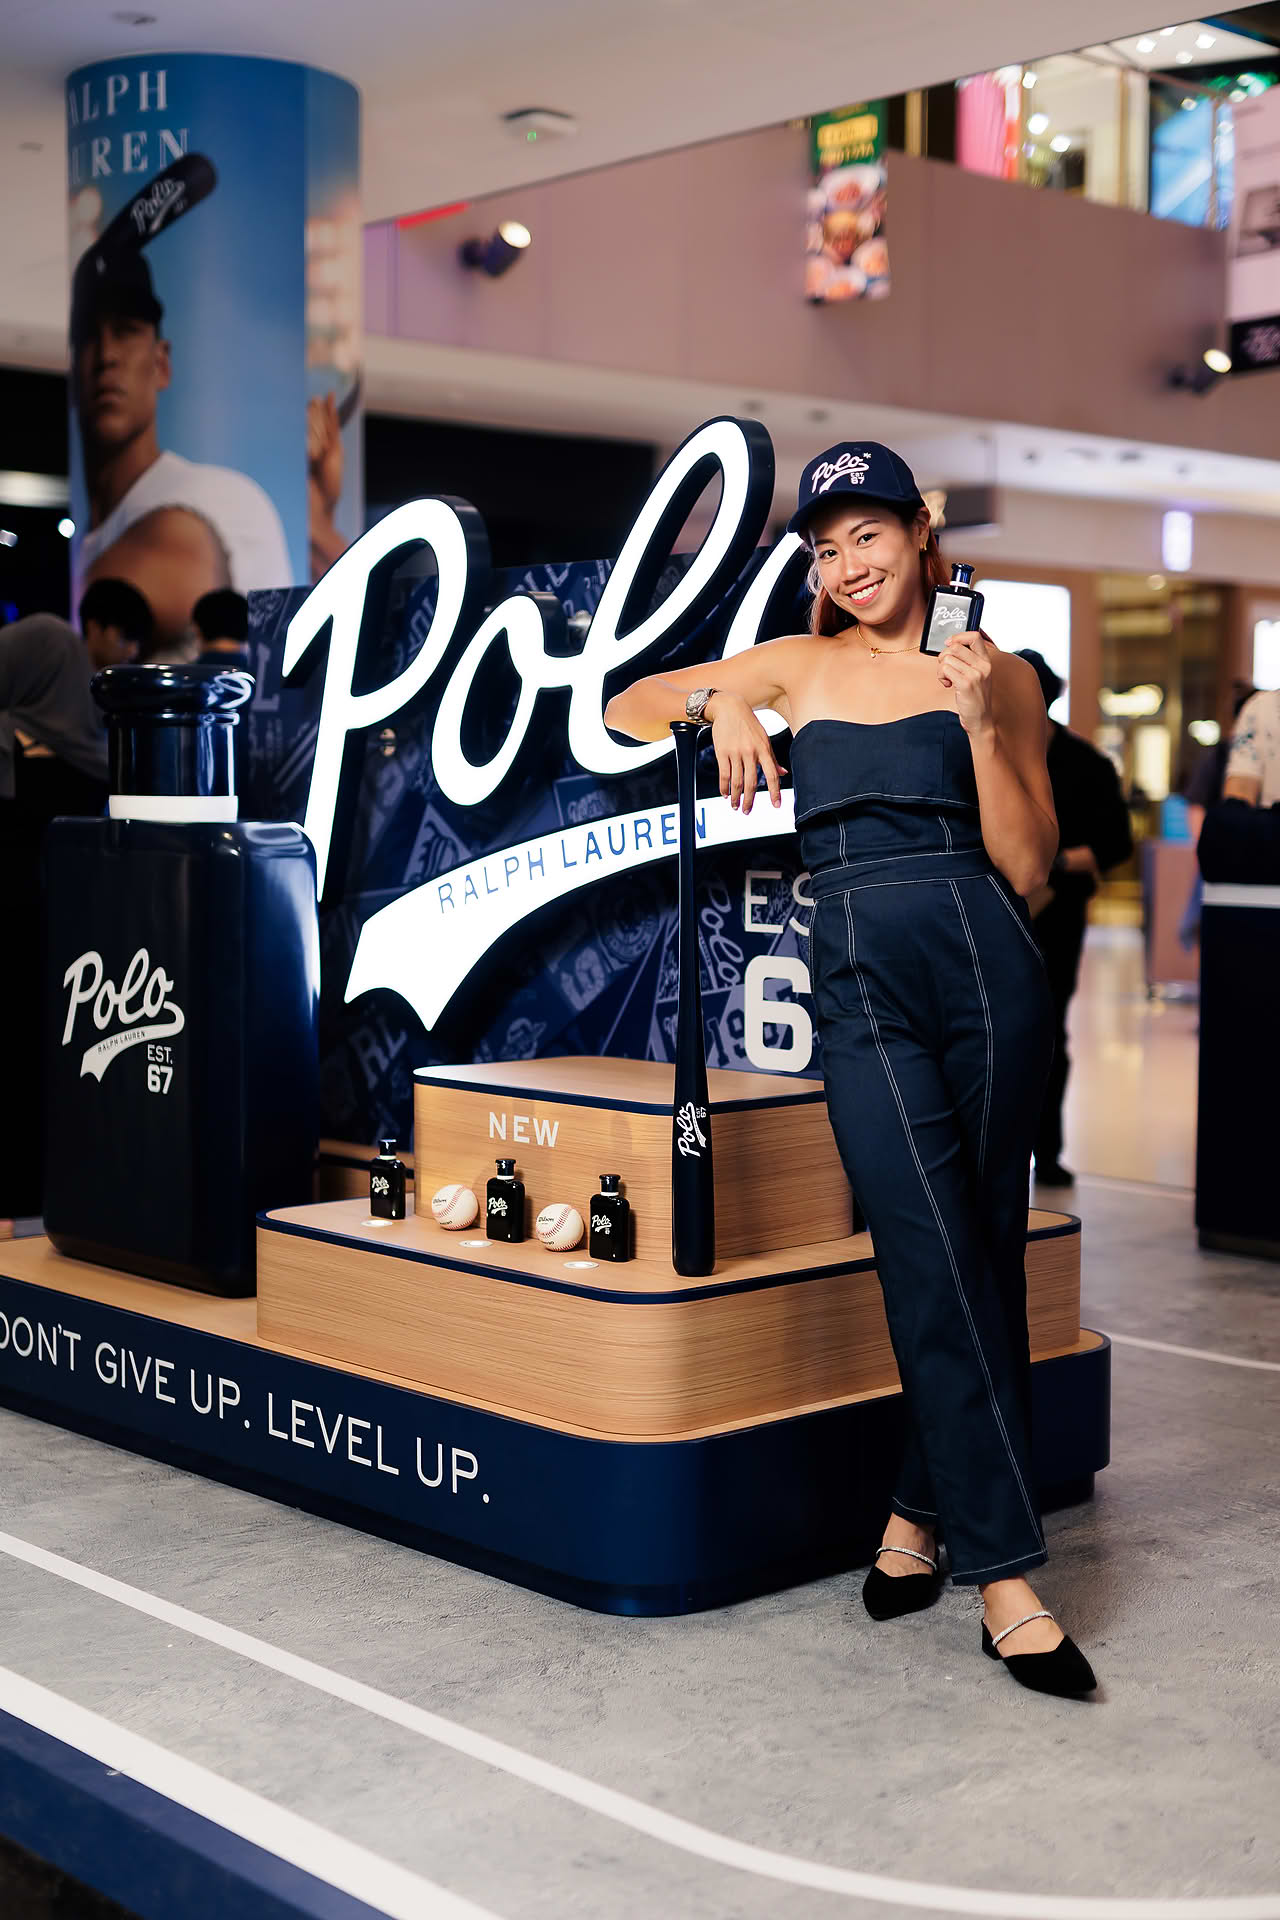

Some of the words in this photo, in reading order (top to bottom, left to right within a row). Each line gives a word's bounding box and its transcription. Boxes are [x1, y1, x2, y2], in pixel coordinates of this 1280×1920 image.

[812, 453, 864, 493] Polo
[934, 606, 966, 620] Polo
[437, 847, 545, 914] RALPH
[561, 807, 707, 869] LAUREN
[62, 947, 175, 1047] Polo
[98, 1037, 119, 1054] RALPH
[120, 1031, 146, 1045] LAUREN
[147, 1044, 173, 1064] EST.
[147, 1063, 173, 1094] 67
[489, 1111, 560, 1147] NEW
[676, 1105, 701, 1157] Polo
[487, 1197, 507, 1210] Polo
[591, 1214, 611, 1228] Polo
[95, 1341, 176, 1404] GIVE
[190, 1368, 250, 1429] UP.
[268, 1392, 399, 1476] LEVEL
[416, 1436, 490, 1504] UP.
